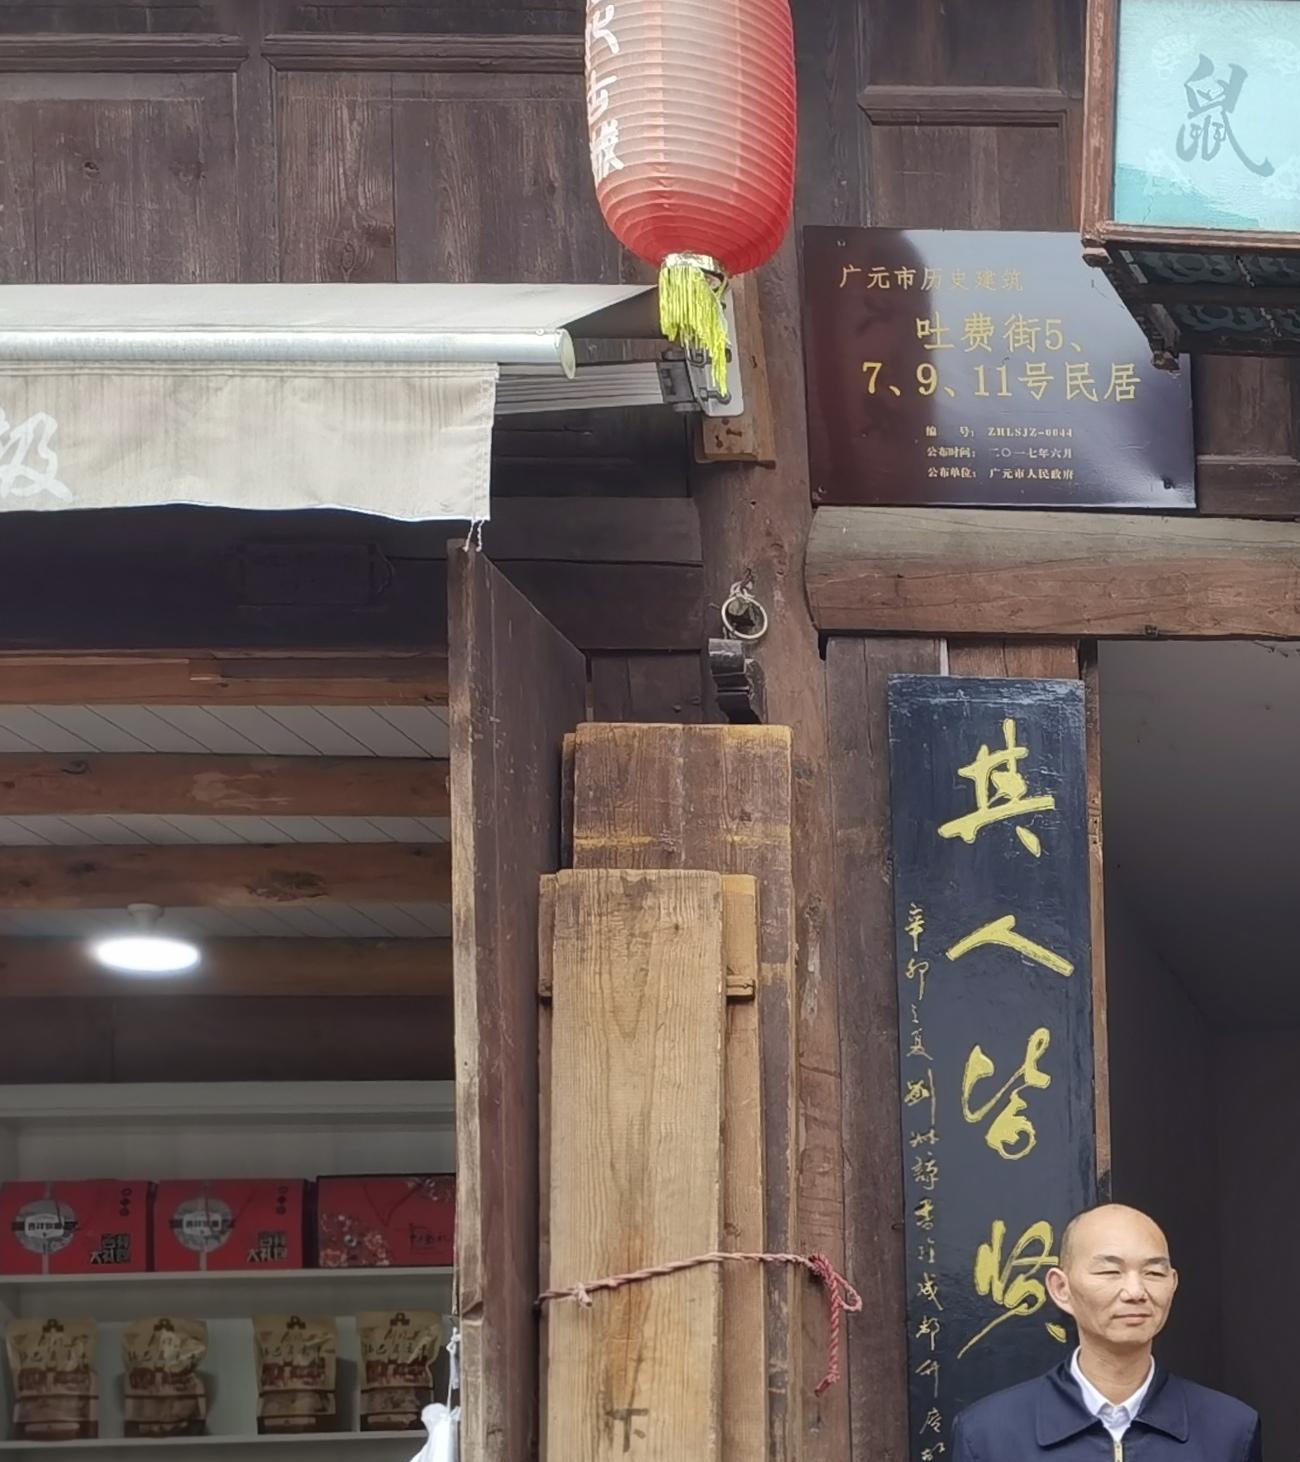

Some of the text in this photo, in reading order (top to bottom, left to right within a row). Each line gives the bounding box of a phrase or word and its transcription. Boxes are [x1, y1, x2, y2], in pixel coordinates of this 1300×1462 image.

[1176, 53, 1274, 177] 鼠
[838, 264, 1024, 292] 广元市历史建筑
[915, 312, 1083, 352] 吐费街5、
[861, 361, 1141, 402] 7、9、11号民居
[989, 466, 1074, 480] 广元市人民政府
